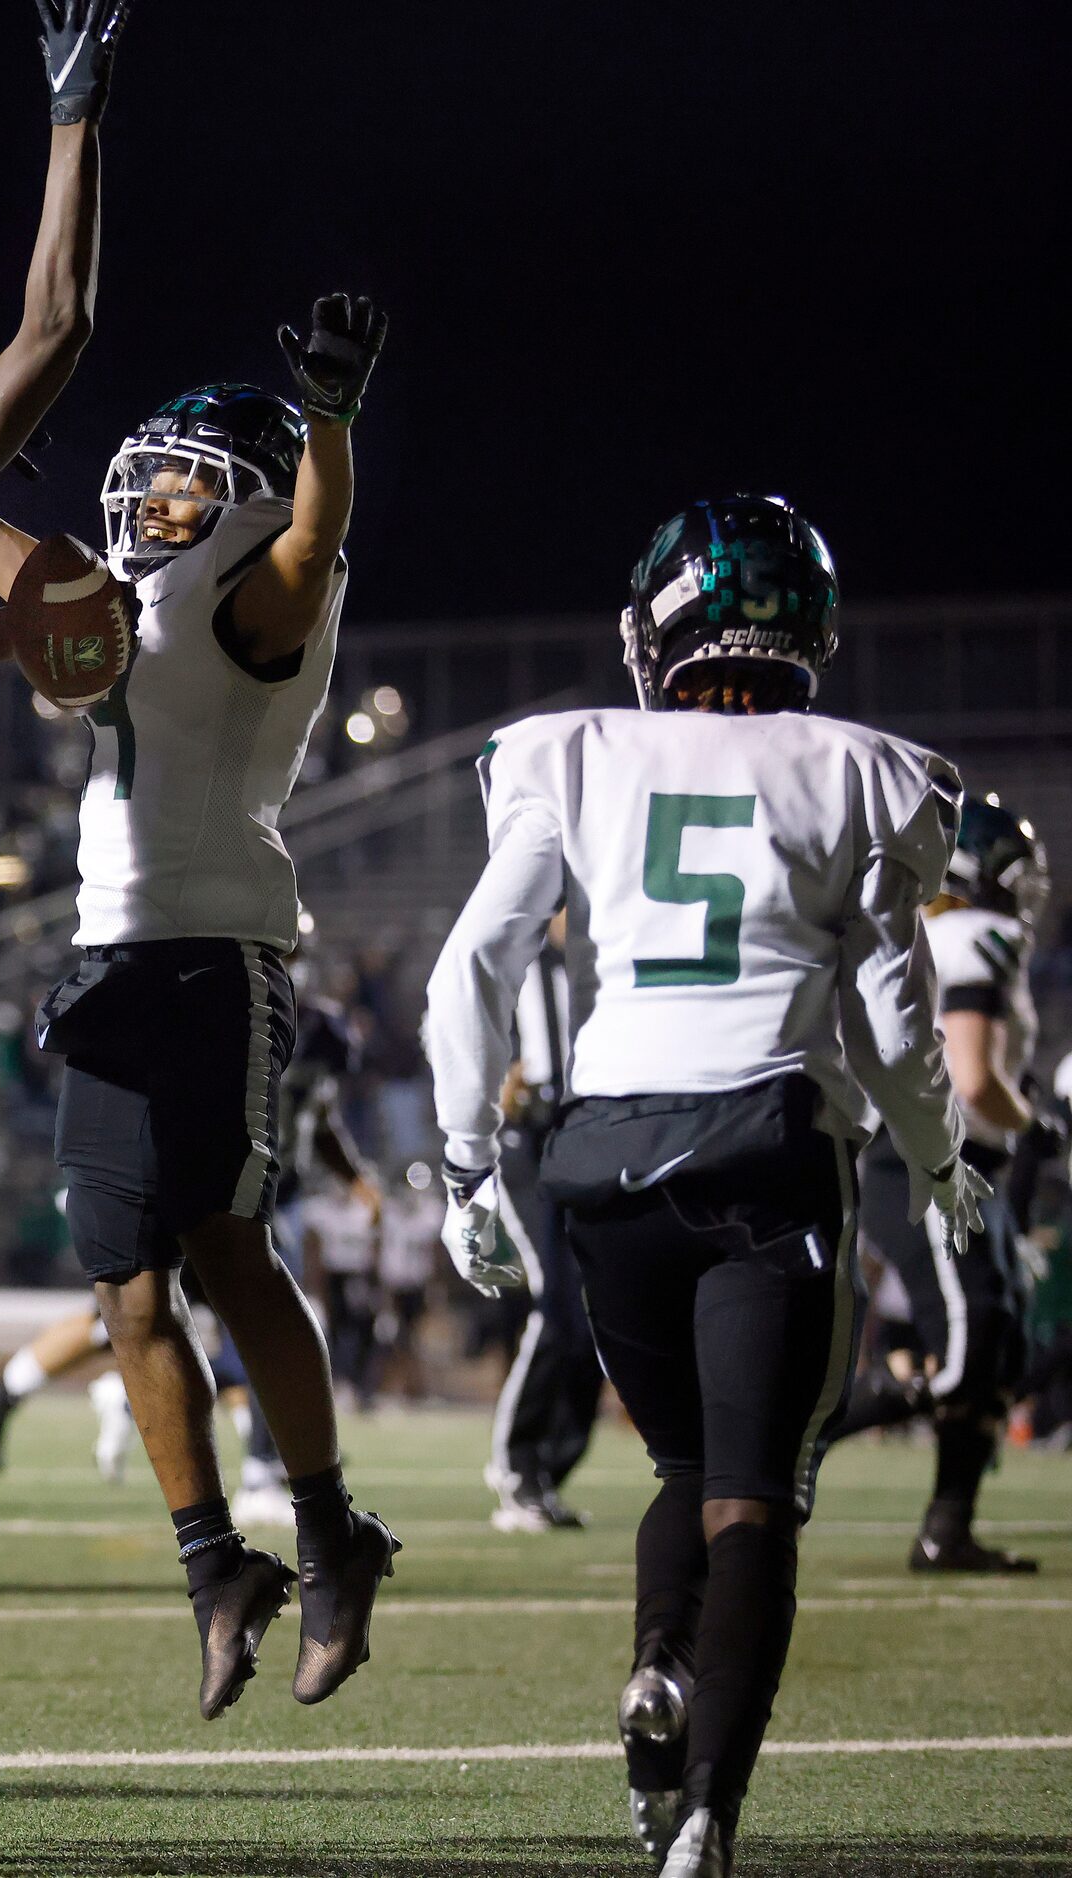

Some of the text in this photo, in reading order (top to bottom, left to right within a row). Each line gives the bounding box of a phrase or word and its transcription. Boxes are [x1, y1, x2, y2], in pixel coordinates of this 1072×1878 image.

[702, 572, 716, 592] B
[720, 625, 792, 646] schutt
[632, 792, 757, 988] 5
